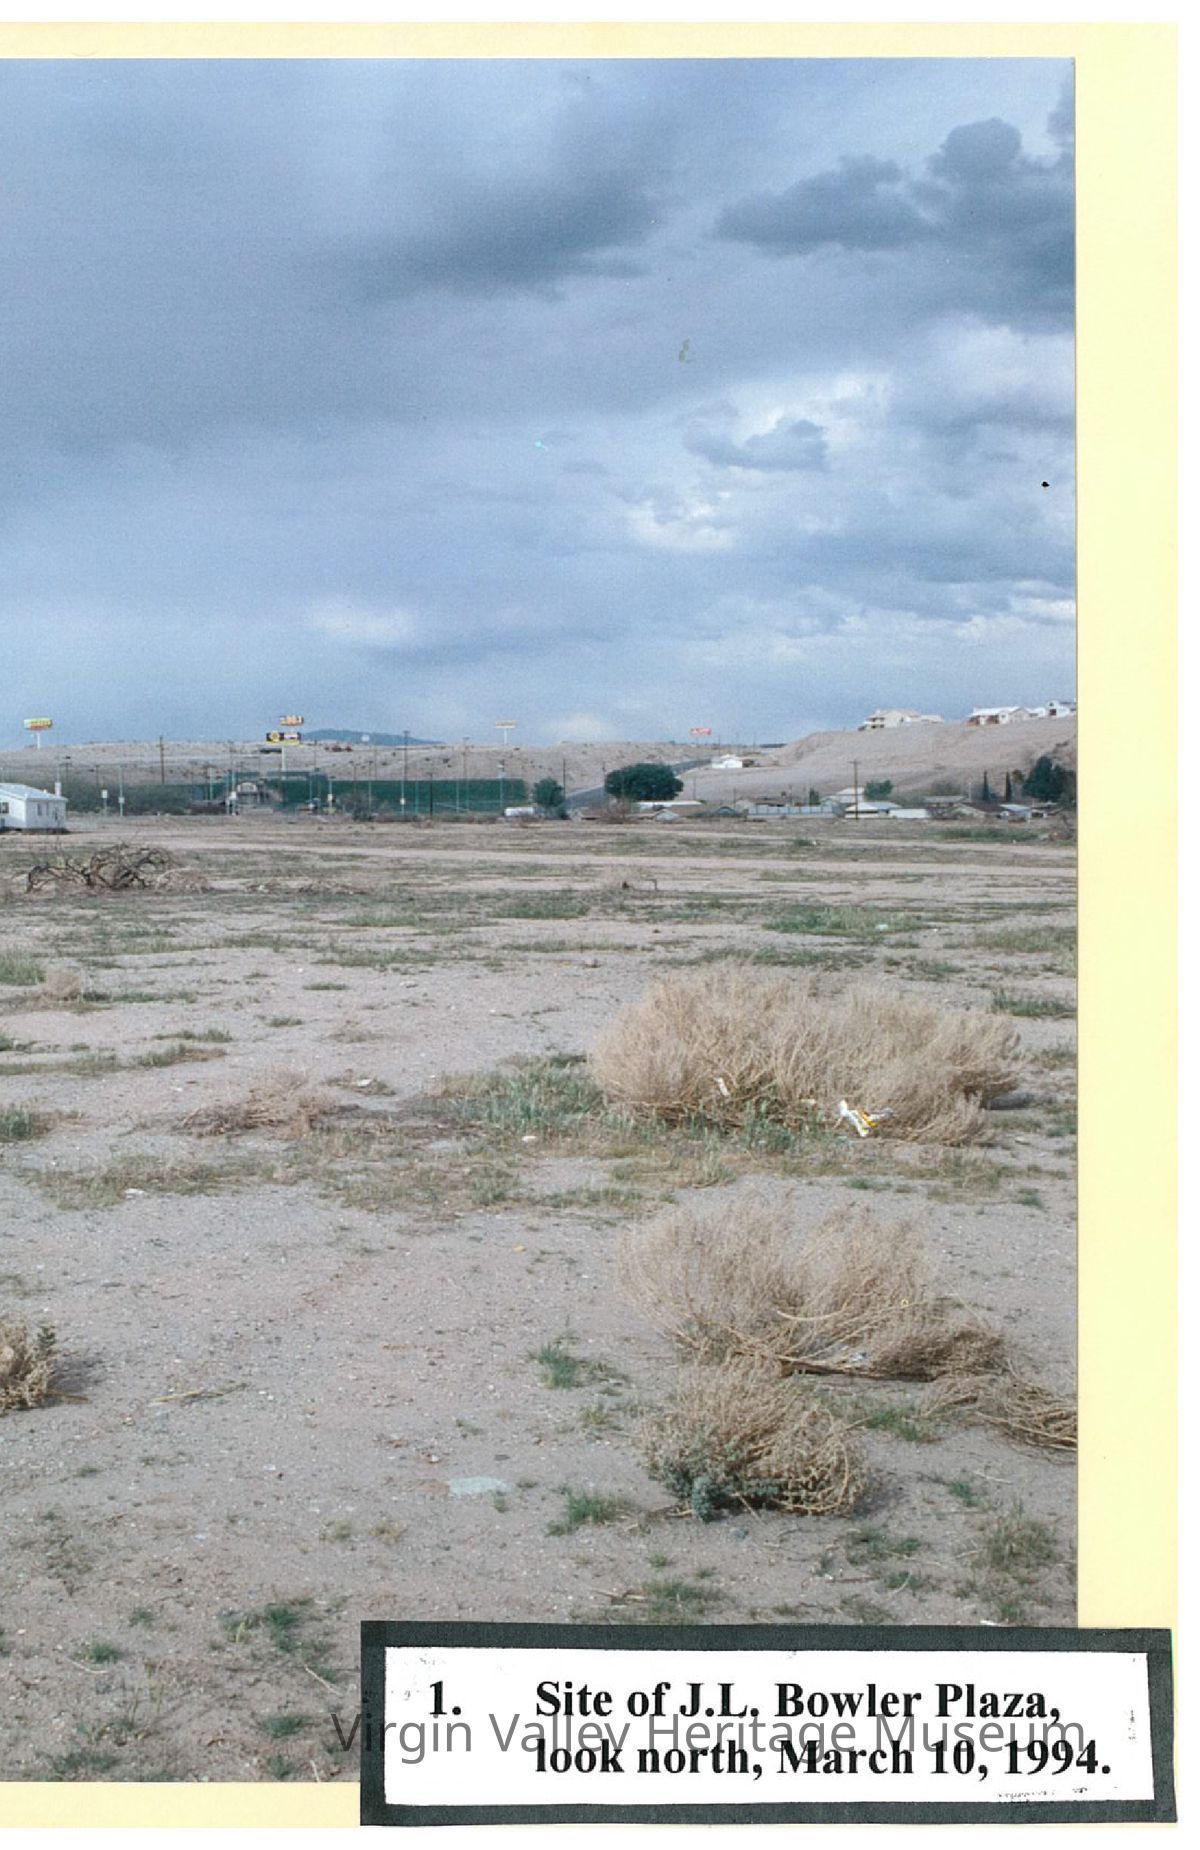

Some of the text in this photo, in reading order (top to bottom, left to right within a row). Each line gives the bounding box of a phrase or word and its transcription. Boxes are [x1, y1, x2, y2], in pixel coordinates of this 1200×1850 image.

[429, 1681, 1061, 1725] 1. Site of J.L. Bowler Plaza,
[535, 1738, 1112, 1781] look north, March 10, 1994.
